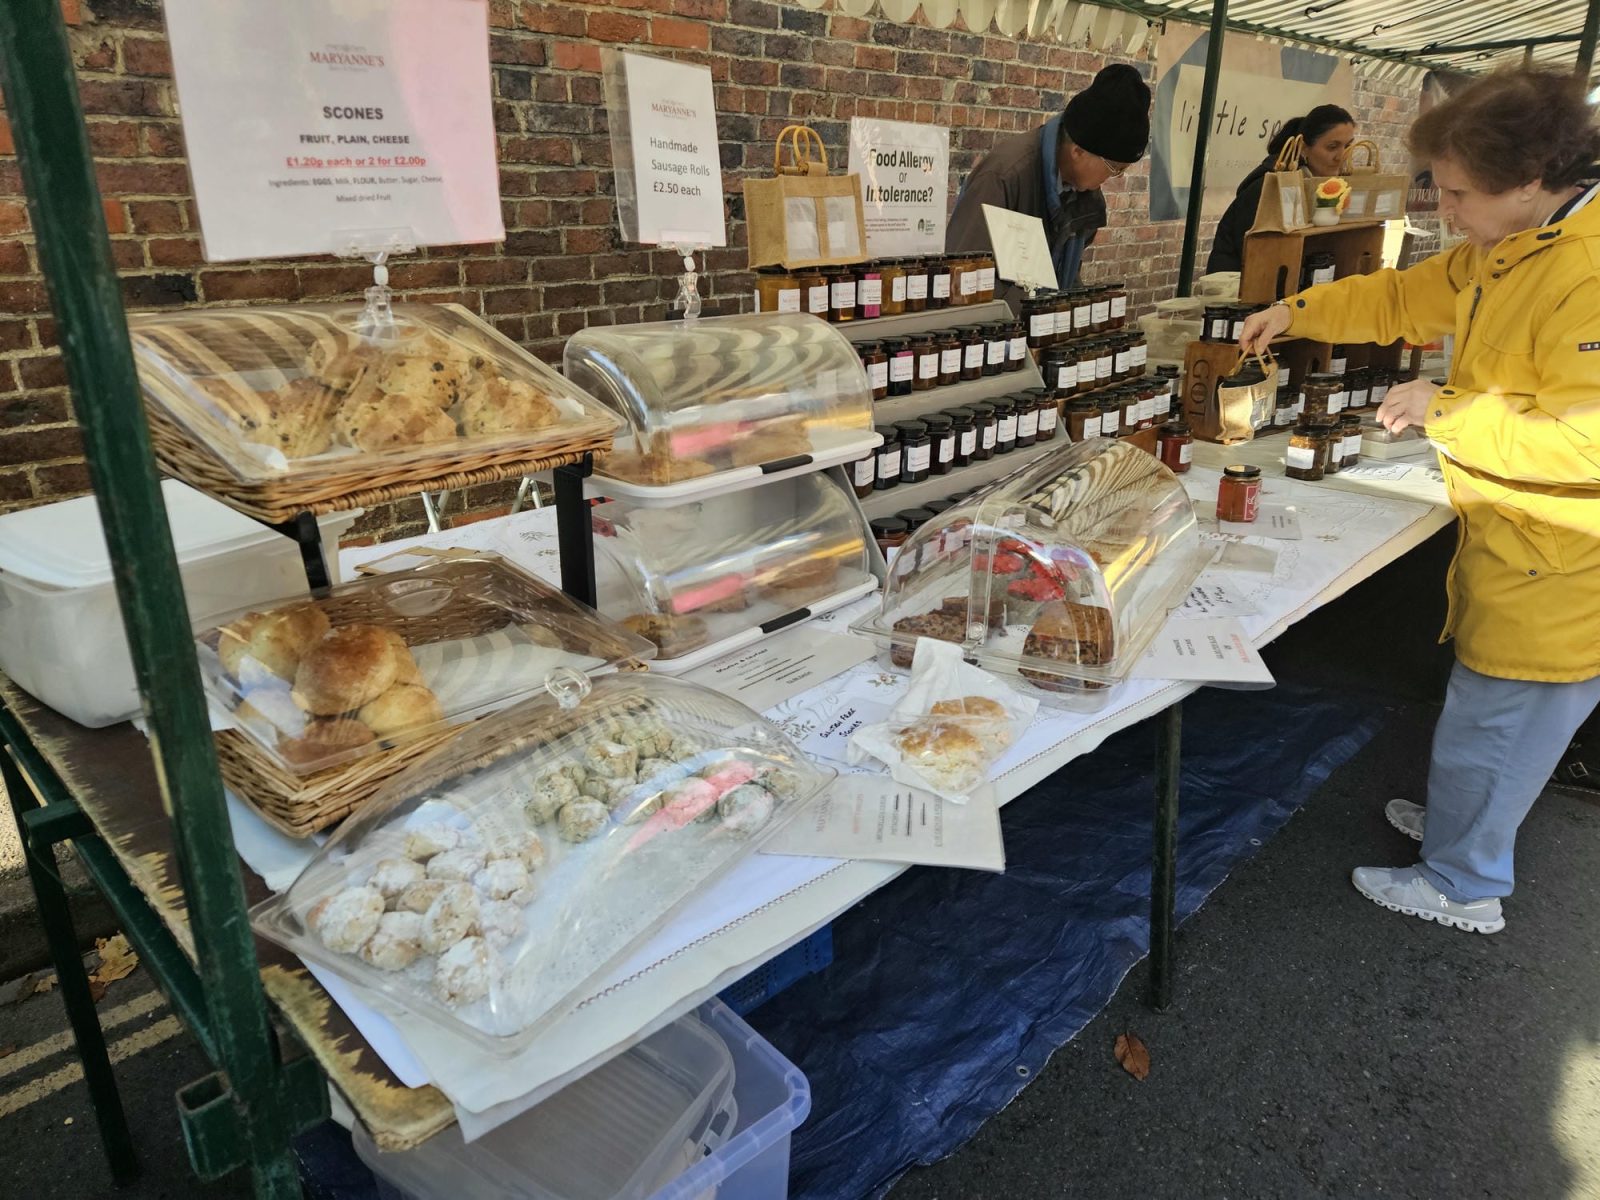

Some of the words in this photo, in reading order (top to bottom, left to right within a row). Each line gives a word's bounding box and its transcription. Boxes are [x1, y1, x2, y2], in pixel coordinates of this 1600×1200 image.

[310, 51, 385, 67] MARYANNE'S
[323, 106, 384, 120] SCONES
[1180, 99, 1247, 136] litle
[1258, 118, 1281, 142] sp
[300, 135, 335, 145] FRUIT,
[337, 135, 370, 145] PLAIN,
[373, 135, 410, 144] CHEESE
[650, 136, 698, 153] Handmade
[286, 157, 324, 168] £1.20p
[327, 157, 352, 167] each
[356, 158, 365, 167] or
[368, 157, 374, 166] 2
[378, 156, 391, 166] for
[394, 155, 426, 167] £2.00p
[651, 159, 688, 176] Sausage
[690, 164, 711, 177] Rolls
[899, 172, 907, 183] or
[653, 181, 679, 194] £2.50
[680, 185, 701, 197] each
